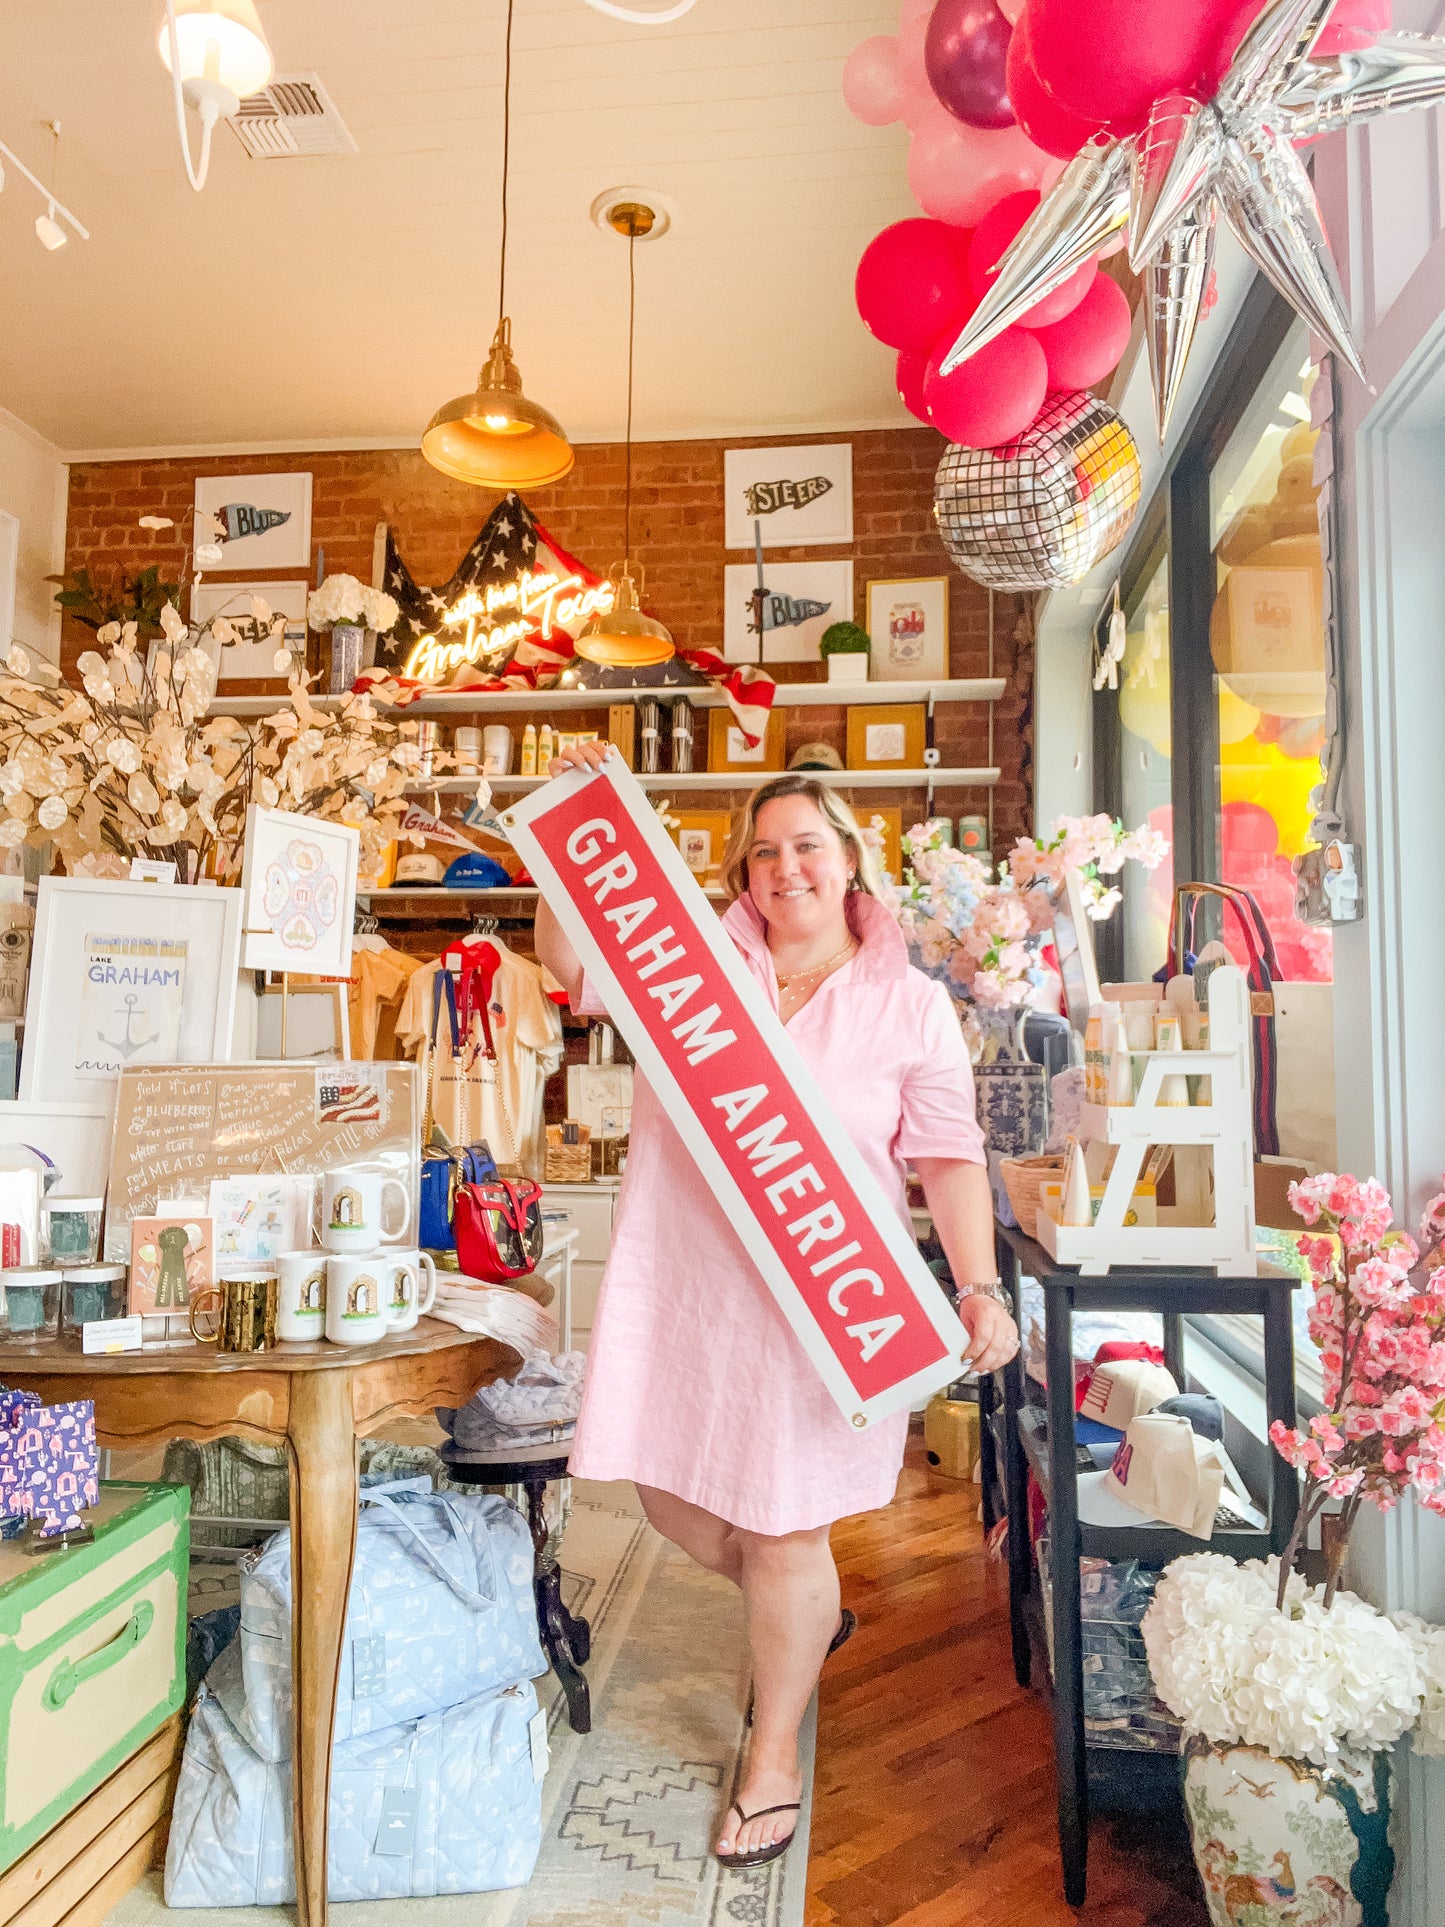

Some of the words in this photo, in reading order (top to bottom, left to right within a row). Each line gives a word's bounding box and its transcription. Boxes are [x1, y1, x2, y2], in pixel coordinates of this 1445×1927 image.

[755, 476, 830, 511] STEERS
[404, 617, 534, 680] Graham
[521, 575, 615, 640] Texas
[89, 956, 112, 964] LAKE
[87, 964, 180, 986] GRAHAM
[134, 1081, 161, 1101] field
[182, 1080, 212, 1096] LOTS
[566, 818, 738, 1067] GRAHAM
[710, 1083, 906, 1365] AMERICA
[149, 1153, 206, 1179] MEATS
[217, 1155, 230, 1165] or
